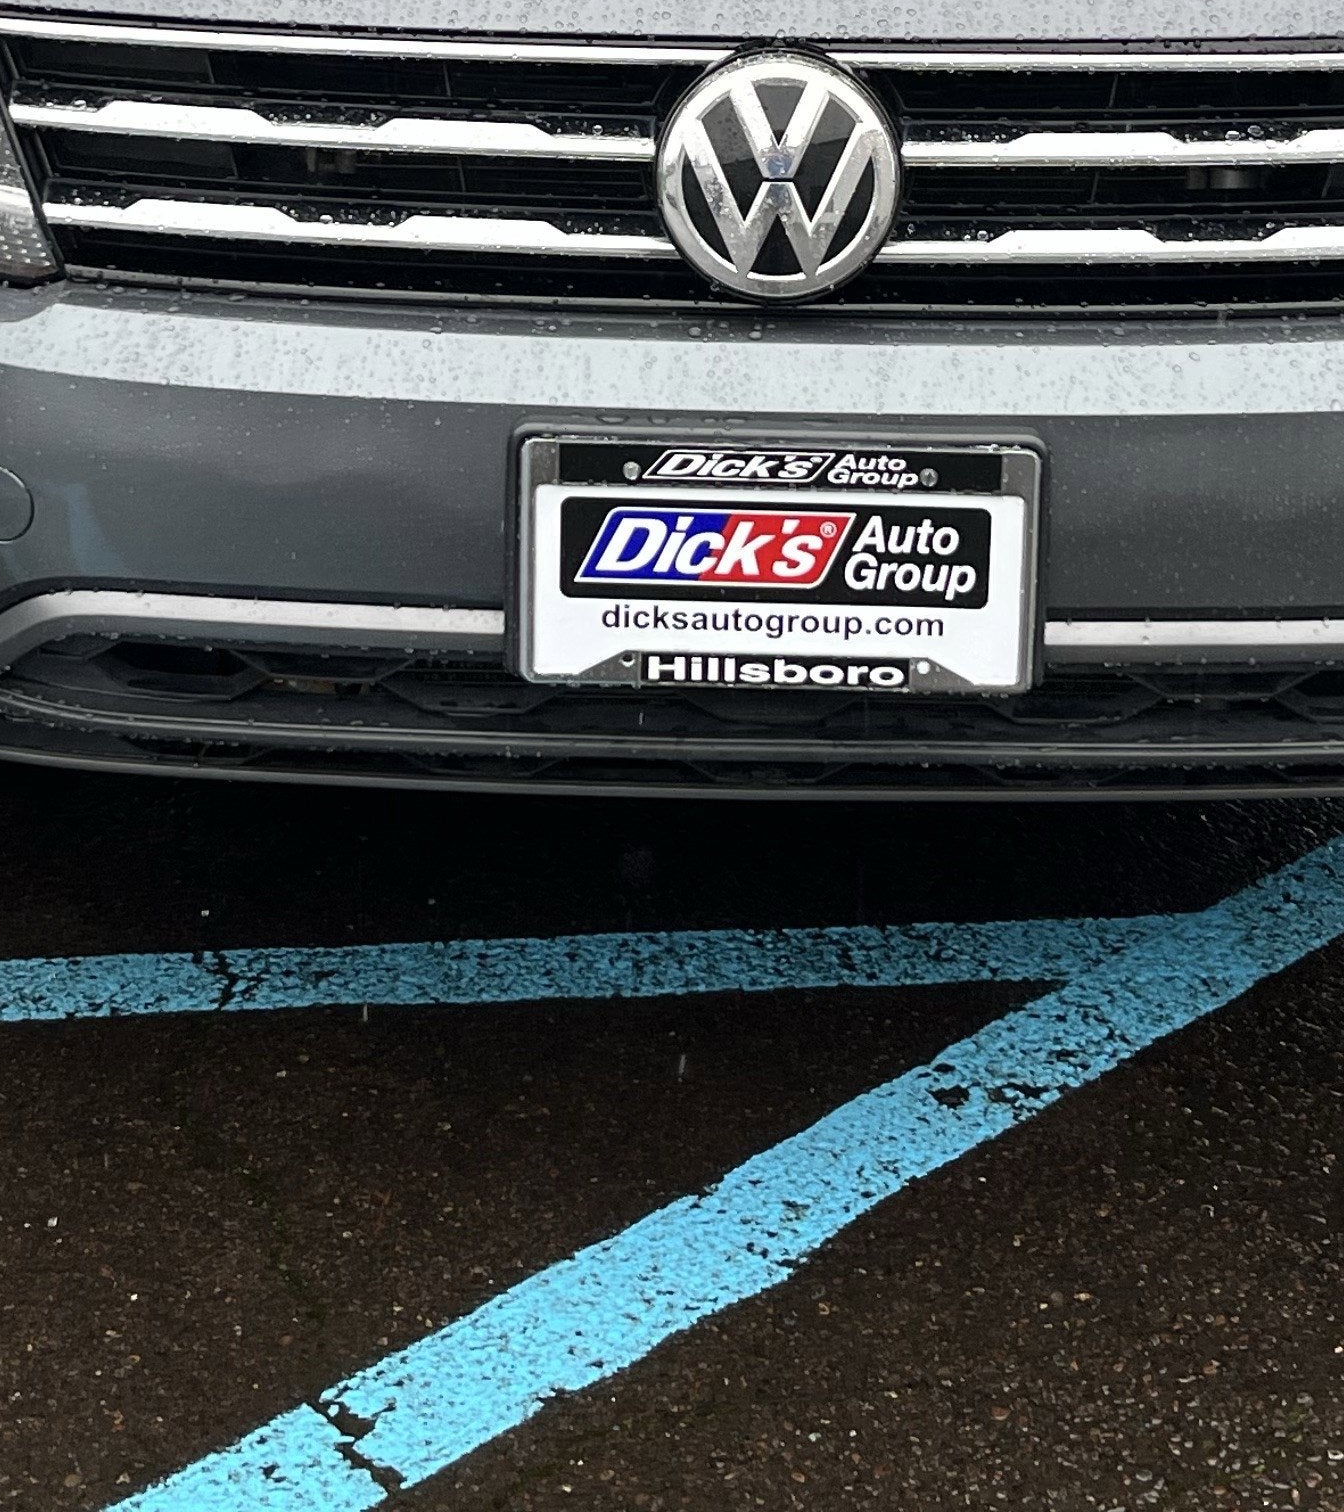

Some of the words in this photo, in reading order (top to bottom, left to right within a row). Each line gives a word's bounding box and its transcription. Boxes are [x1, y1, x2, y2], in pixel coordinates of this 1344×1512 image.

[656, 452, 813, 479] Dick's
[834, 453, 907, 471] Auto
[827, 468, 920, 488] Group
[595, 515, 823, 578] Dick's
[852, 516, 960, 555] Auto
[844, 553, 977, 601] Group
[601, 604, 945, 640] dicksautogroup.com
[646, 655, 905, 687] Hillsboro
